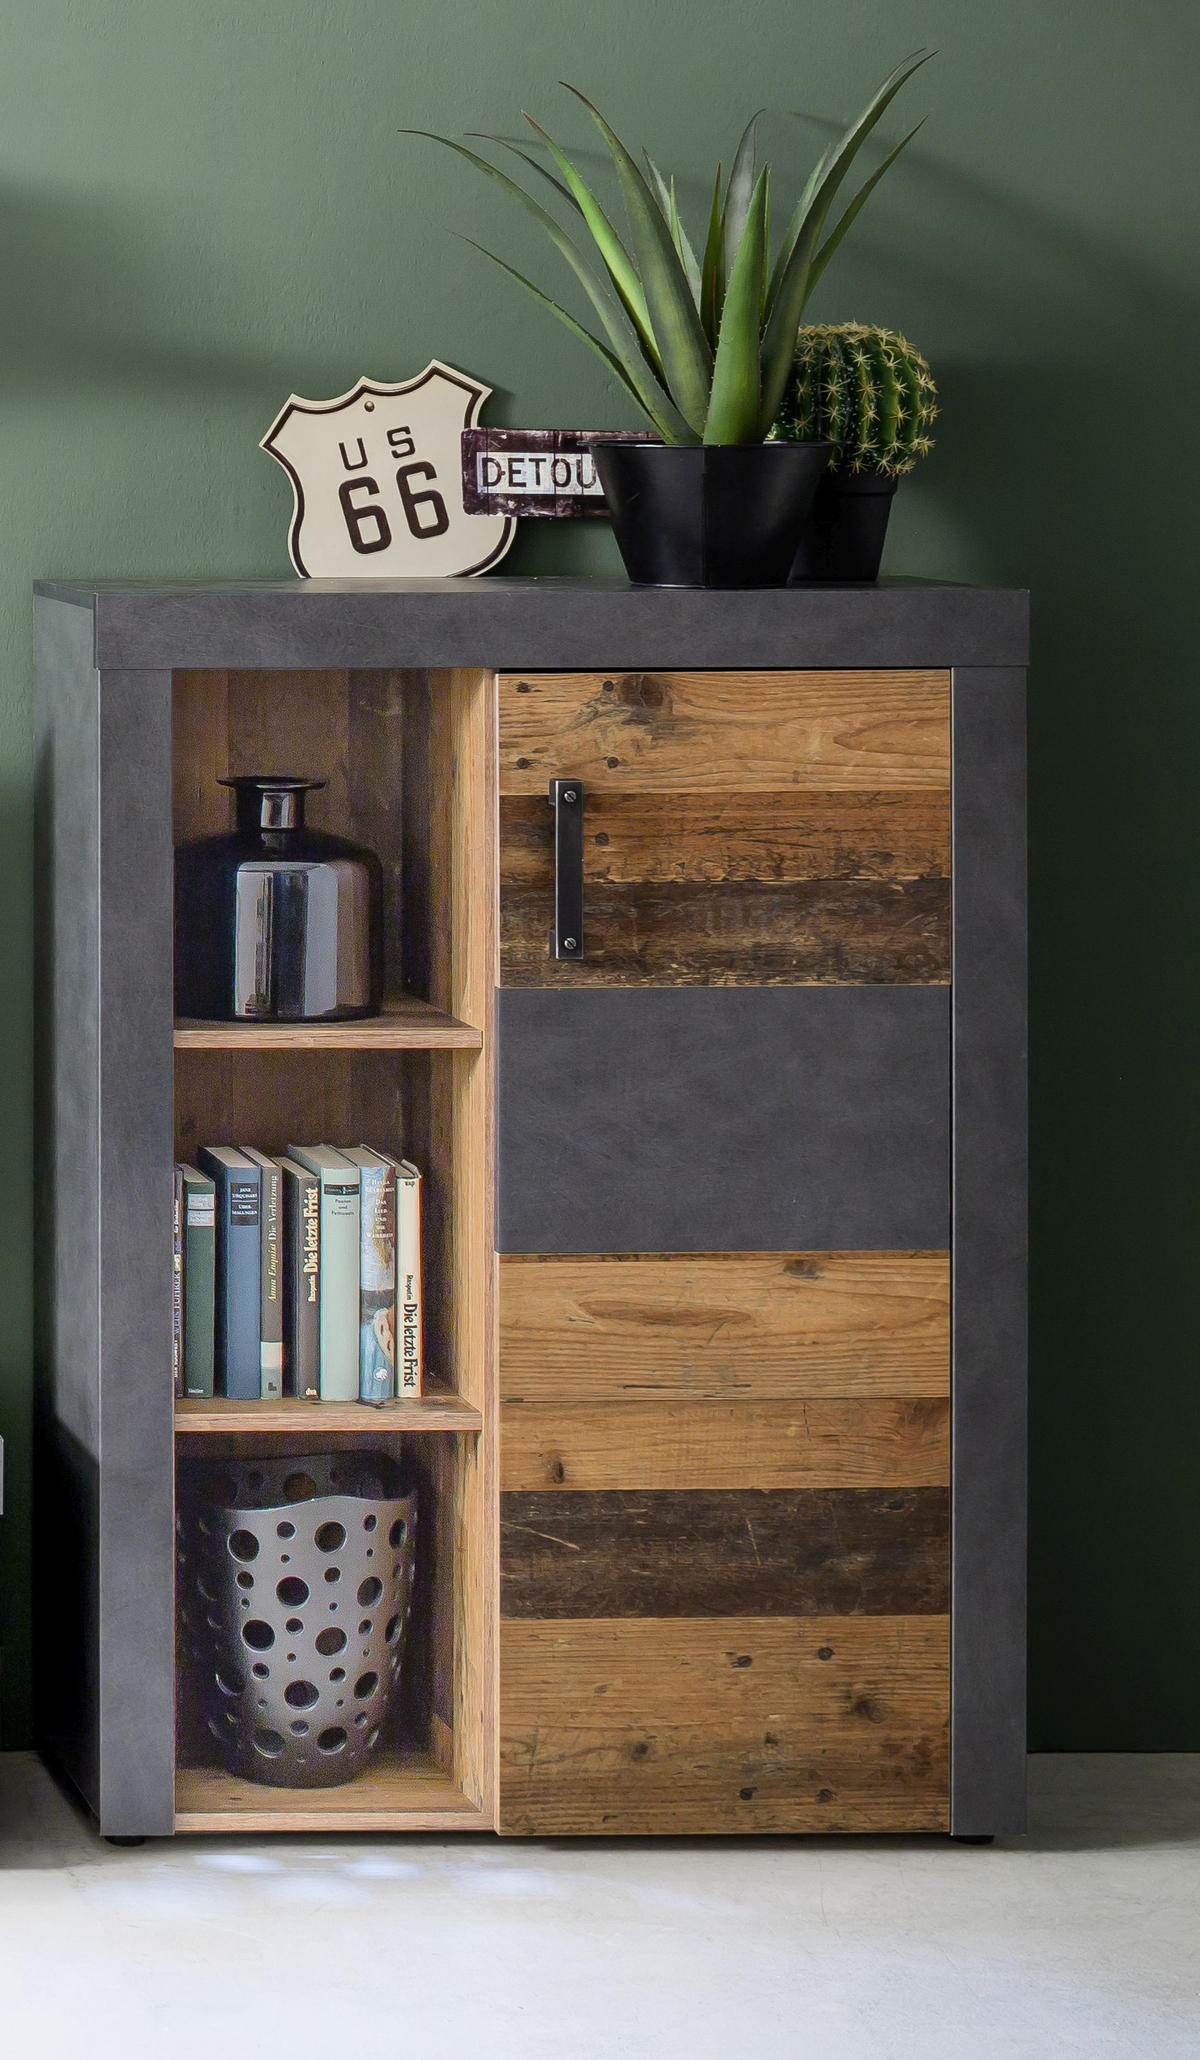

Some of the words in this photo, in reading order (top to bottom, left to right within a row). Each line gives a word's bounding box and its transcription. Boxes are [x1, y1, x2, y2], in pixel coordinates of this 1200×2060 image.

[338, 460, 450, 555] 66
[268, 1175, 279, 1222] Verletzung
[303, 1187, 318, 1218] Frist
[268, 1225, 277, 1241] Die
[303, 1219, 318, 1251] letzte
[303, 1252, 318, 1273] Die
[403, 1303, 418, 1323] Die
[403, 1325, 418, 1357] letzte
[403, 1357, 418, 1388] Frist
